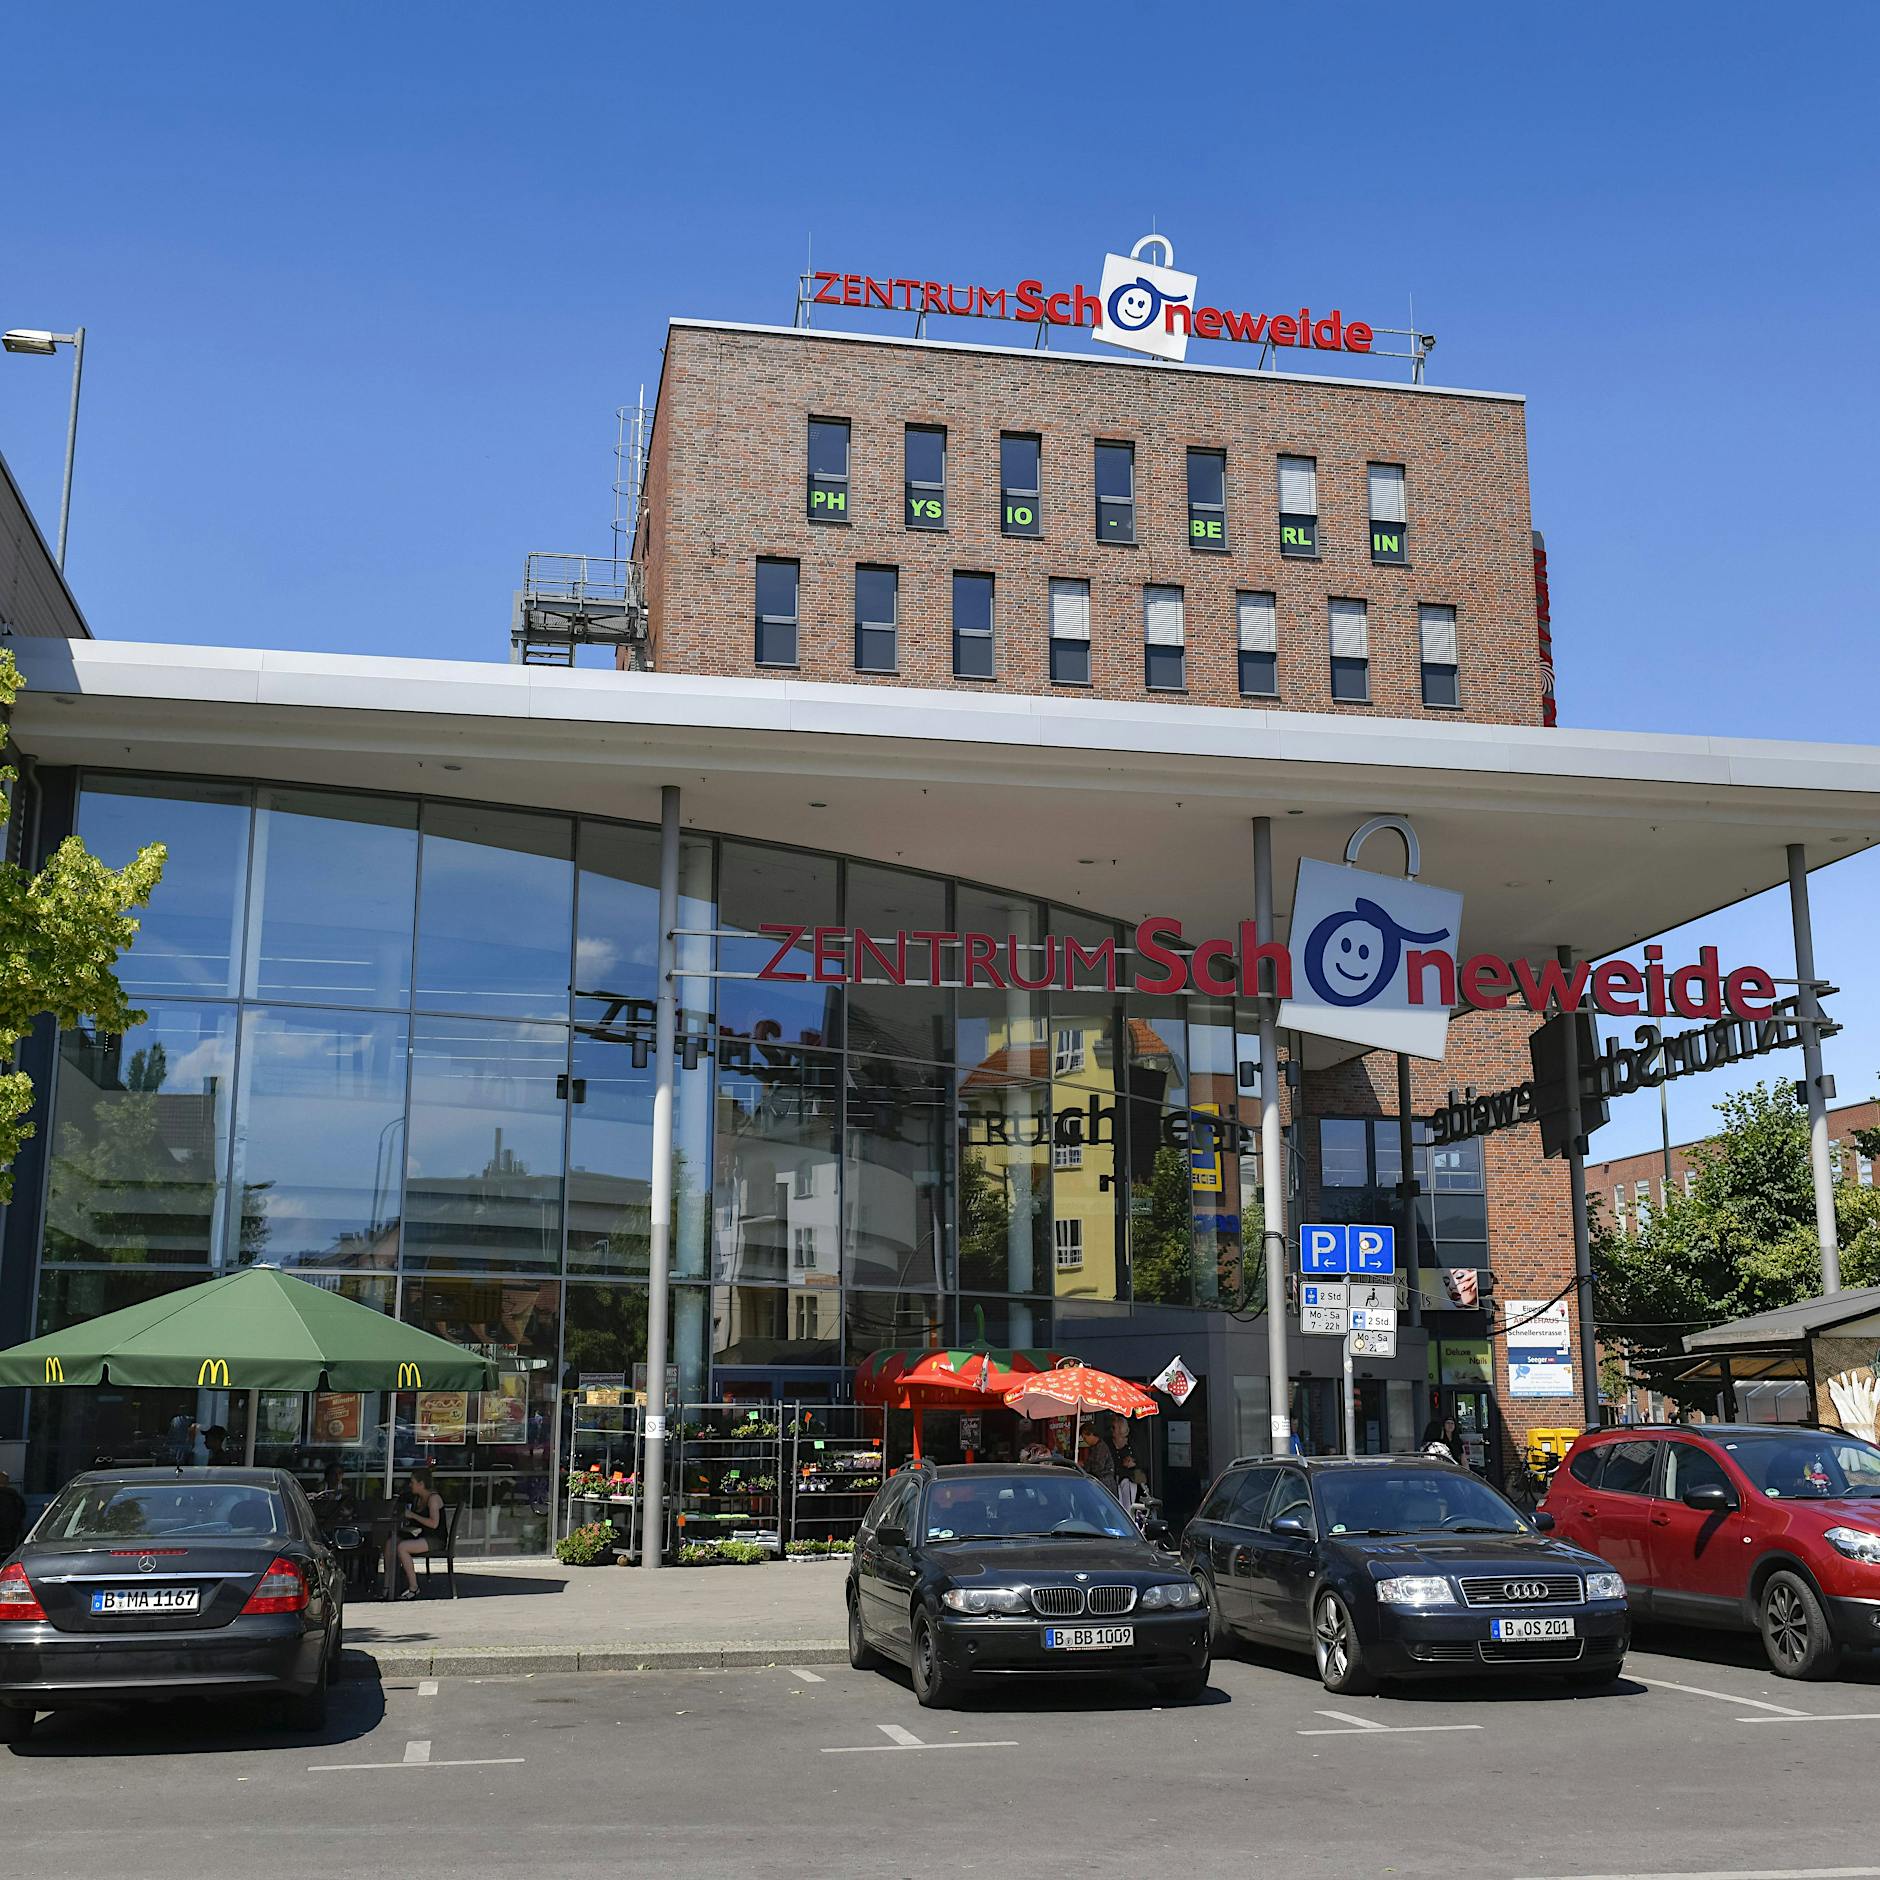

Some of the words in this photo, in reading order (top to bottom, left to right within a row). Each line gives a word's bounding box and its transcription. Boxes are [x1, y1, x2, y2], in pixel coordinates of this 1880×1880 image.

[813, 271, 1006, 318] ZENTRUM
[811, 491, 845, 512] PH
[910, 500, 942, 519] YS
[1007, 507, 1033, 525] IO
[1192, 520, 1222, 539] BE
[1282, 527, 1312, 546] RL
[1374, 534, 1399, 552] IN
[757, 922, 1116, 992] ZENTRUM
[1312, 1231, 1336, 1267] P
[1359, 1232, 1383, 1267] P
[1309, 1310, 1322, 1319] Mo
[1329, 1311, 1340, 1320] Sa
[1368, 1317, 1373, 1326] 2
[1311, 1321, 1316, 1330] 7
[1377, 1333, 1388, 1342] Sa
[1445, 1347, 1471, 1356] Deluxe
[1527, 1356, 1548, 1364] Seeger
[104, 1592, 115, 1608] B
[127, 1591, 149, 1608] MA
[153, 1590, 196, 1607] 1167
[1505, 1621, 1514, 1636] B
[1524, 1621, 1541, 1635] OS
[1545, 1620, 1569, 1635] 201
[1055, 1631, 1064, 1646] B
[1074, 1630, 1093, 1645] BB
[1096, 1628, 1131, 1644] 1009
